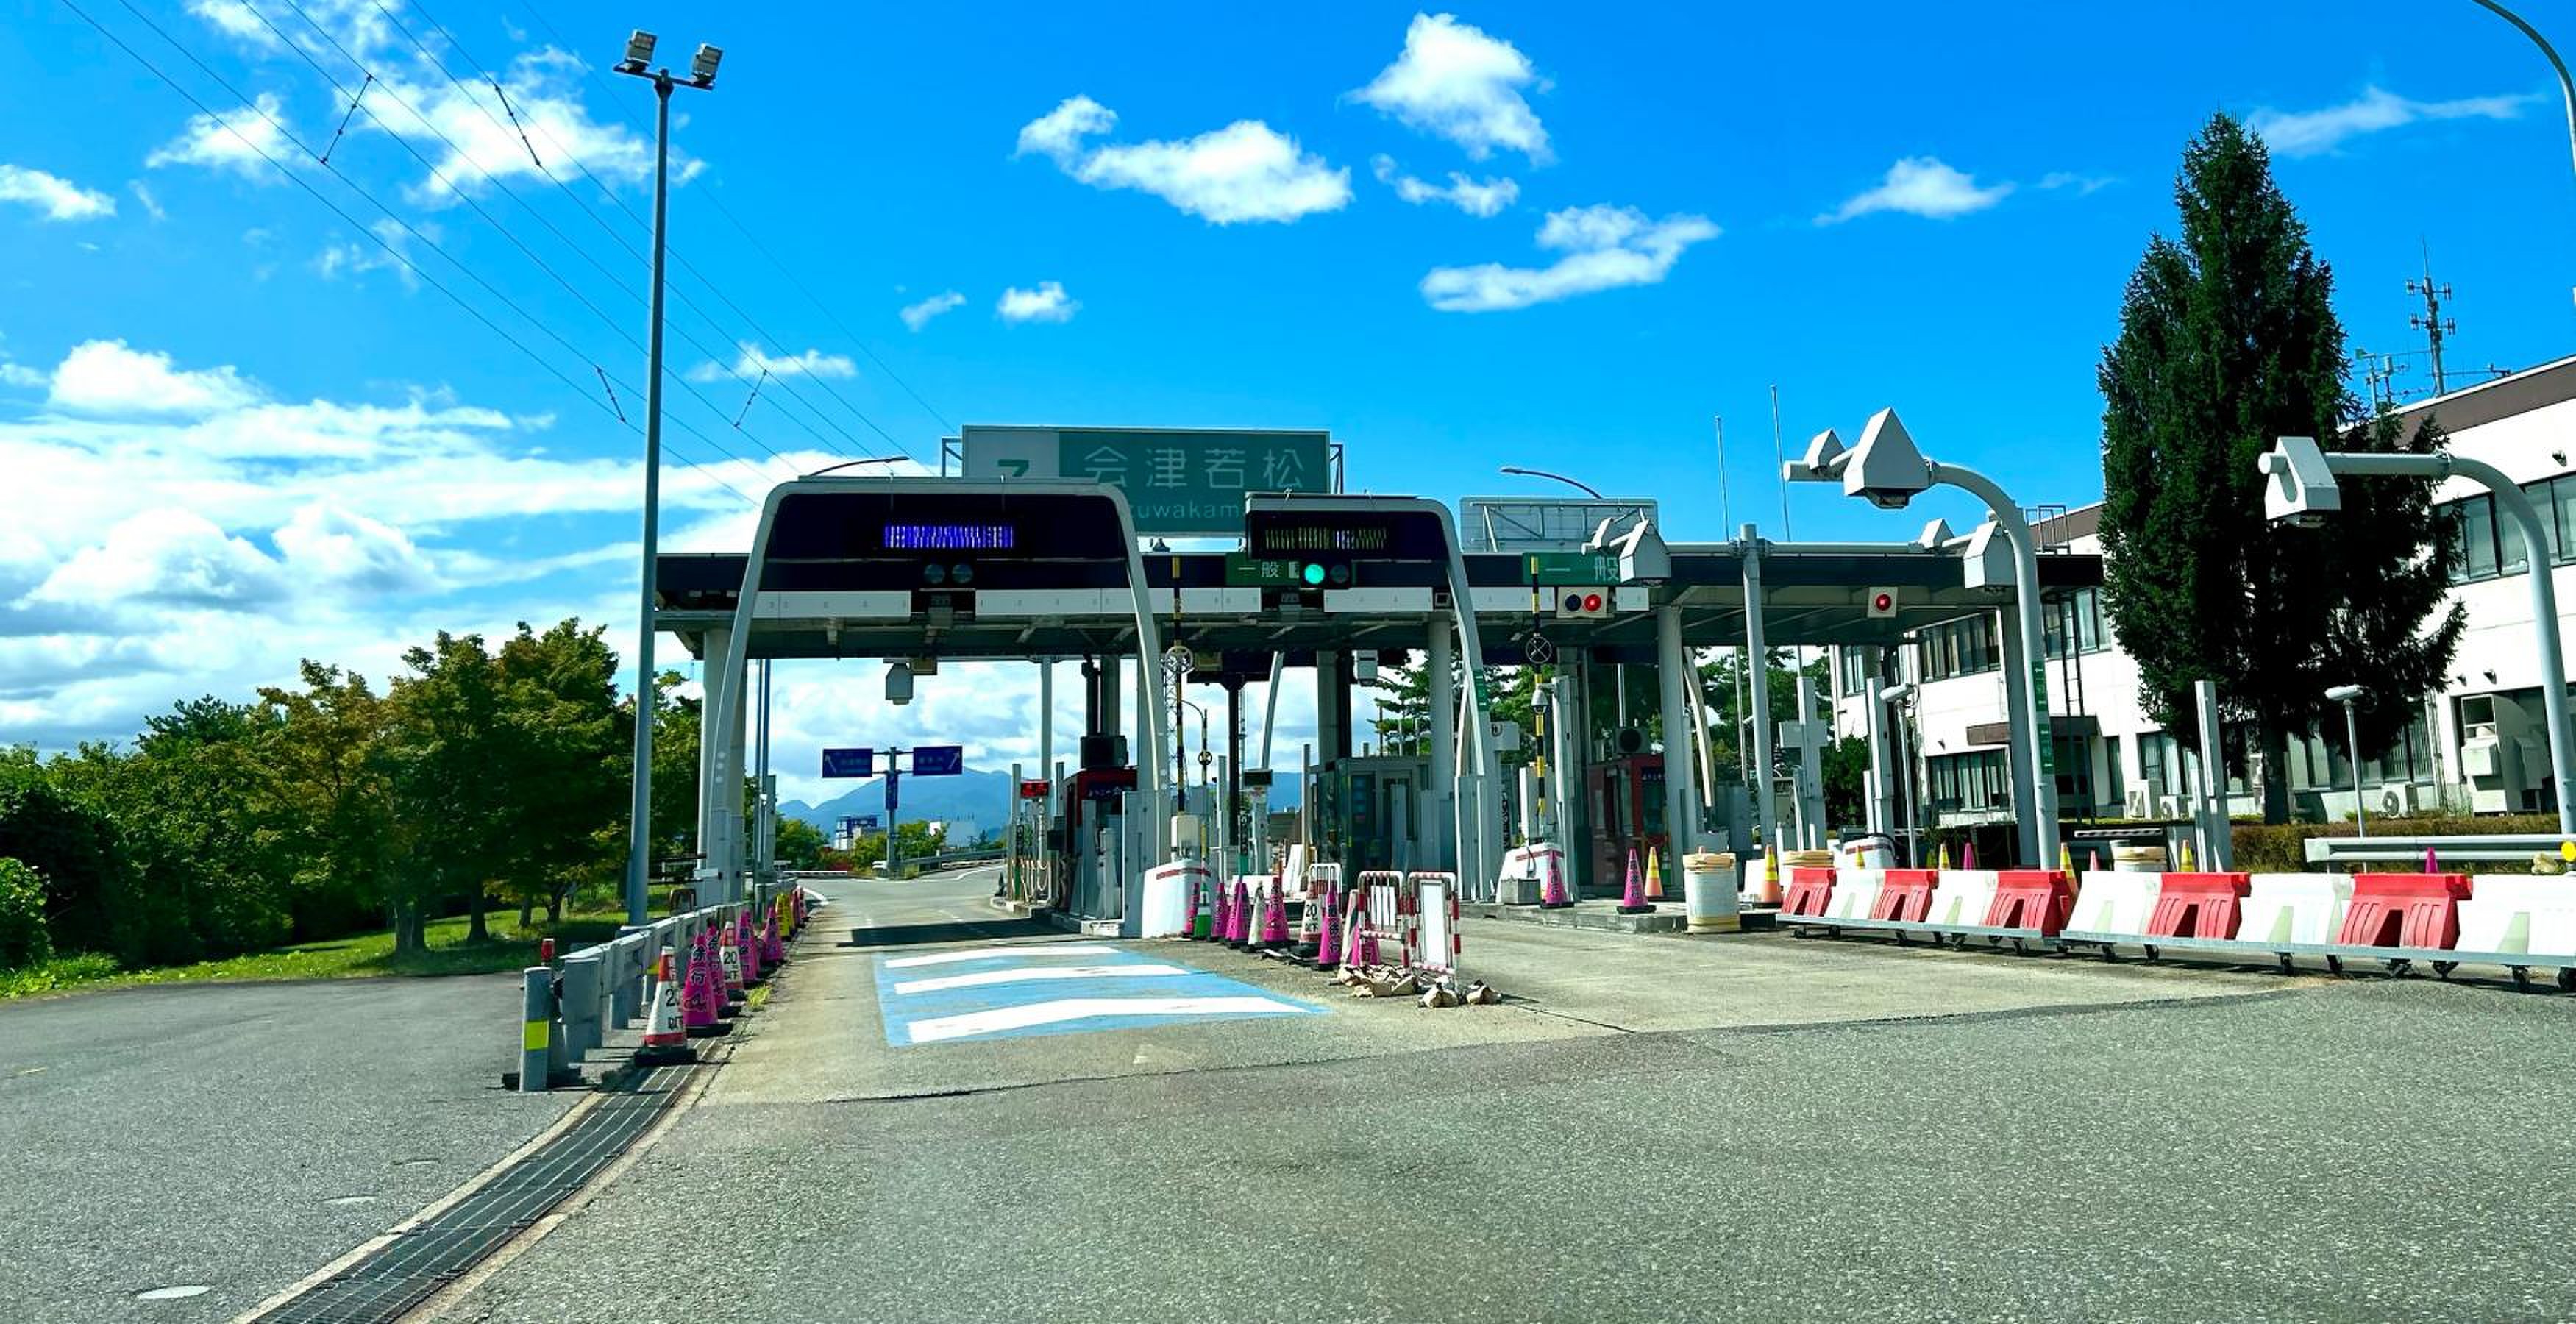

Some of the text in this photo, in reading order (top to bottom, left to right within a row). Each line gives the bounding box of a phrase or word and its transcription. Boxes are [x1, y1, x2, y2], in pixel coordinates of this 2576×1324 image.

[1084, 446, 1305, 488] 会津若松
[1237, 561, 1279, 577] 一般
[1545, 556, 1619, 581] 一般
[723, 952, 737, 964] 20
